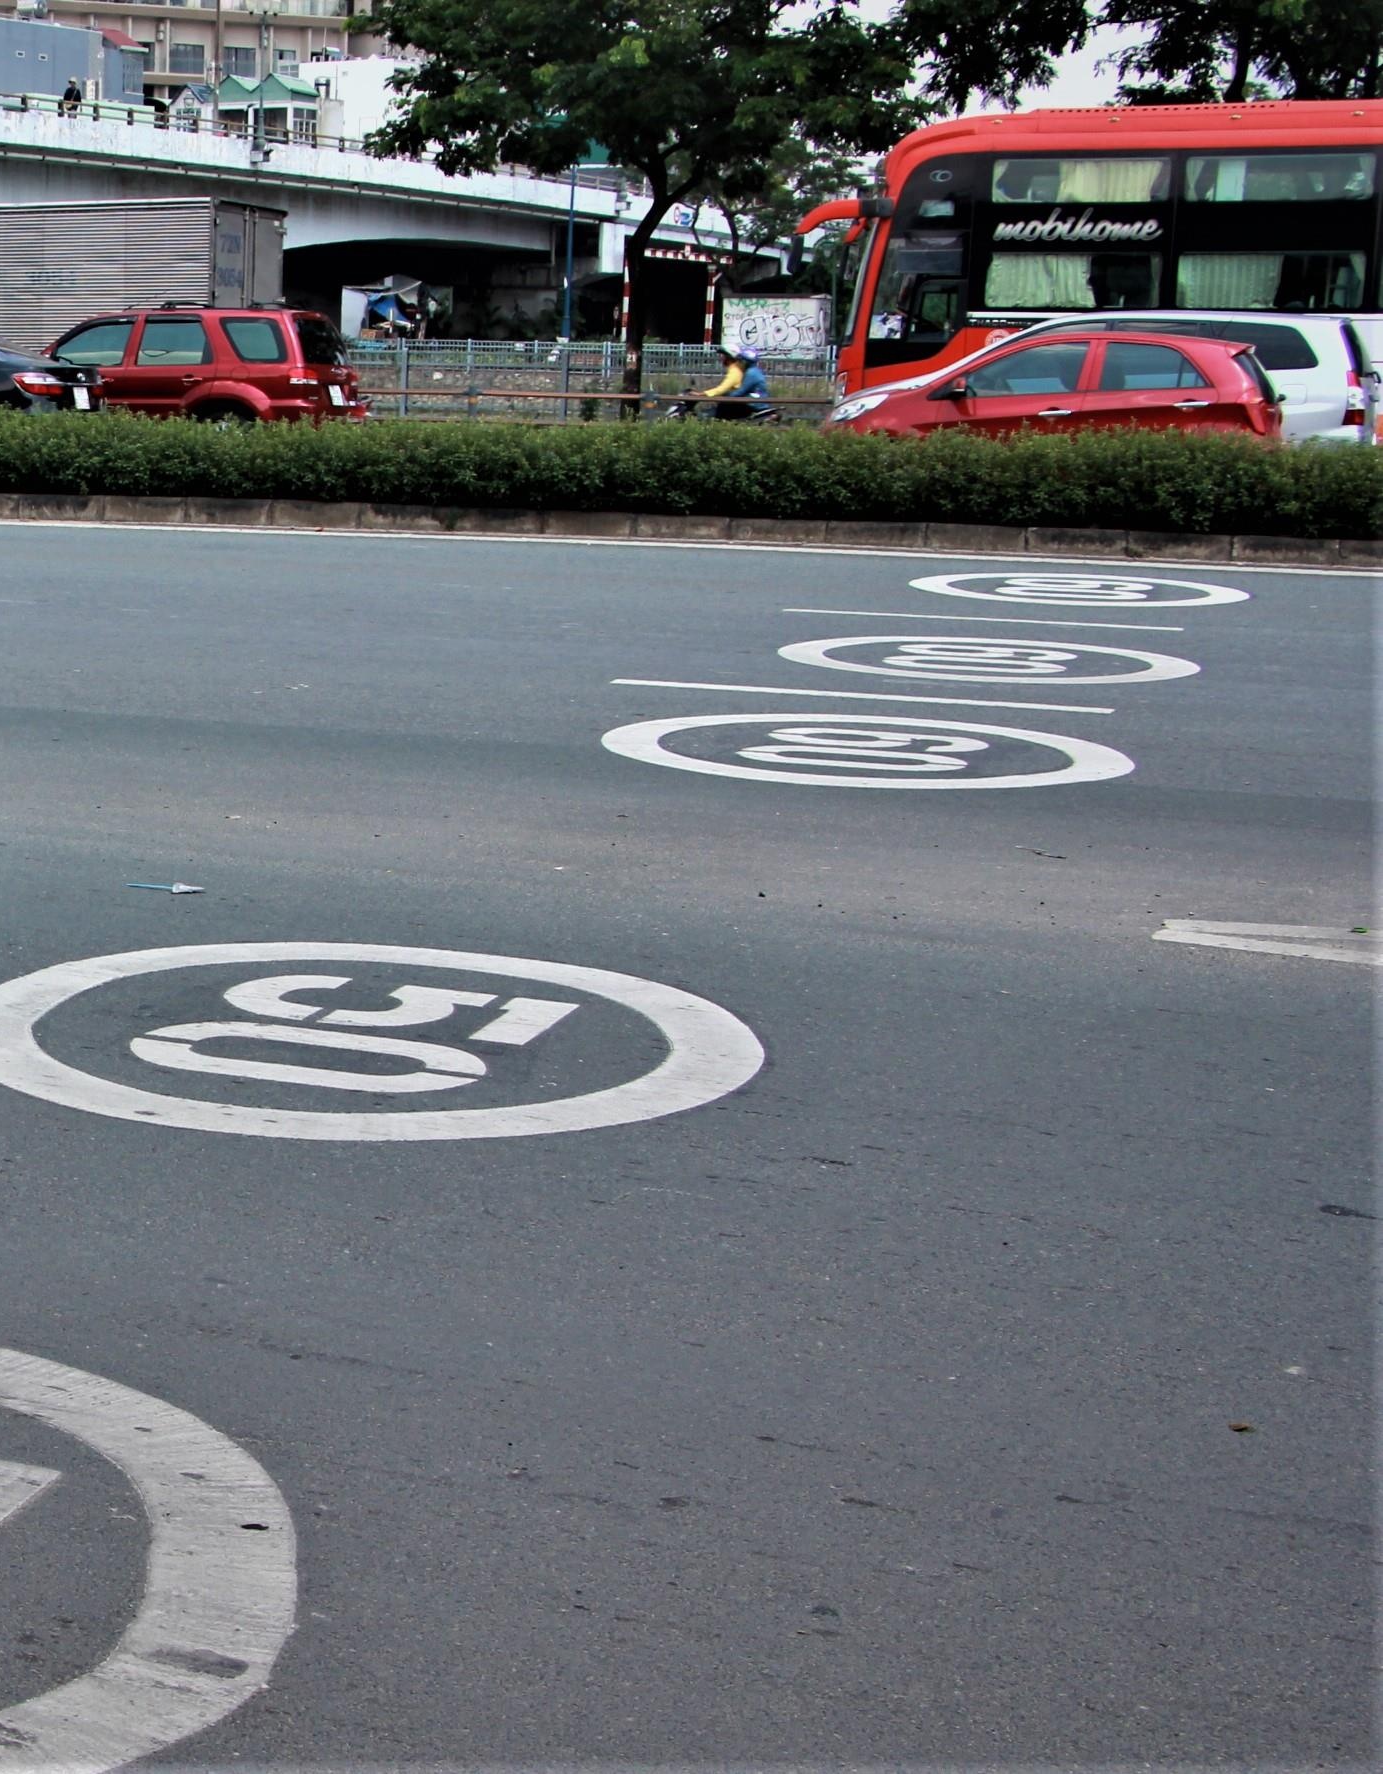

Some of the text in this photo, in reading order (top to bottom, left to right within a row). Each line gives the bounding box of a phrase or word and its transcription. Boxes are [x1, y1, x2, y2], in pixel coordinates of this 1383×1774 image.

[992, 208, 1163, 241] mobihome
[736, 727, 990, 772] 60
[129, 974, 580, 1093] 50
